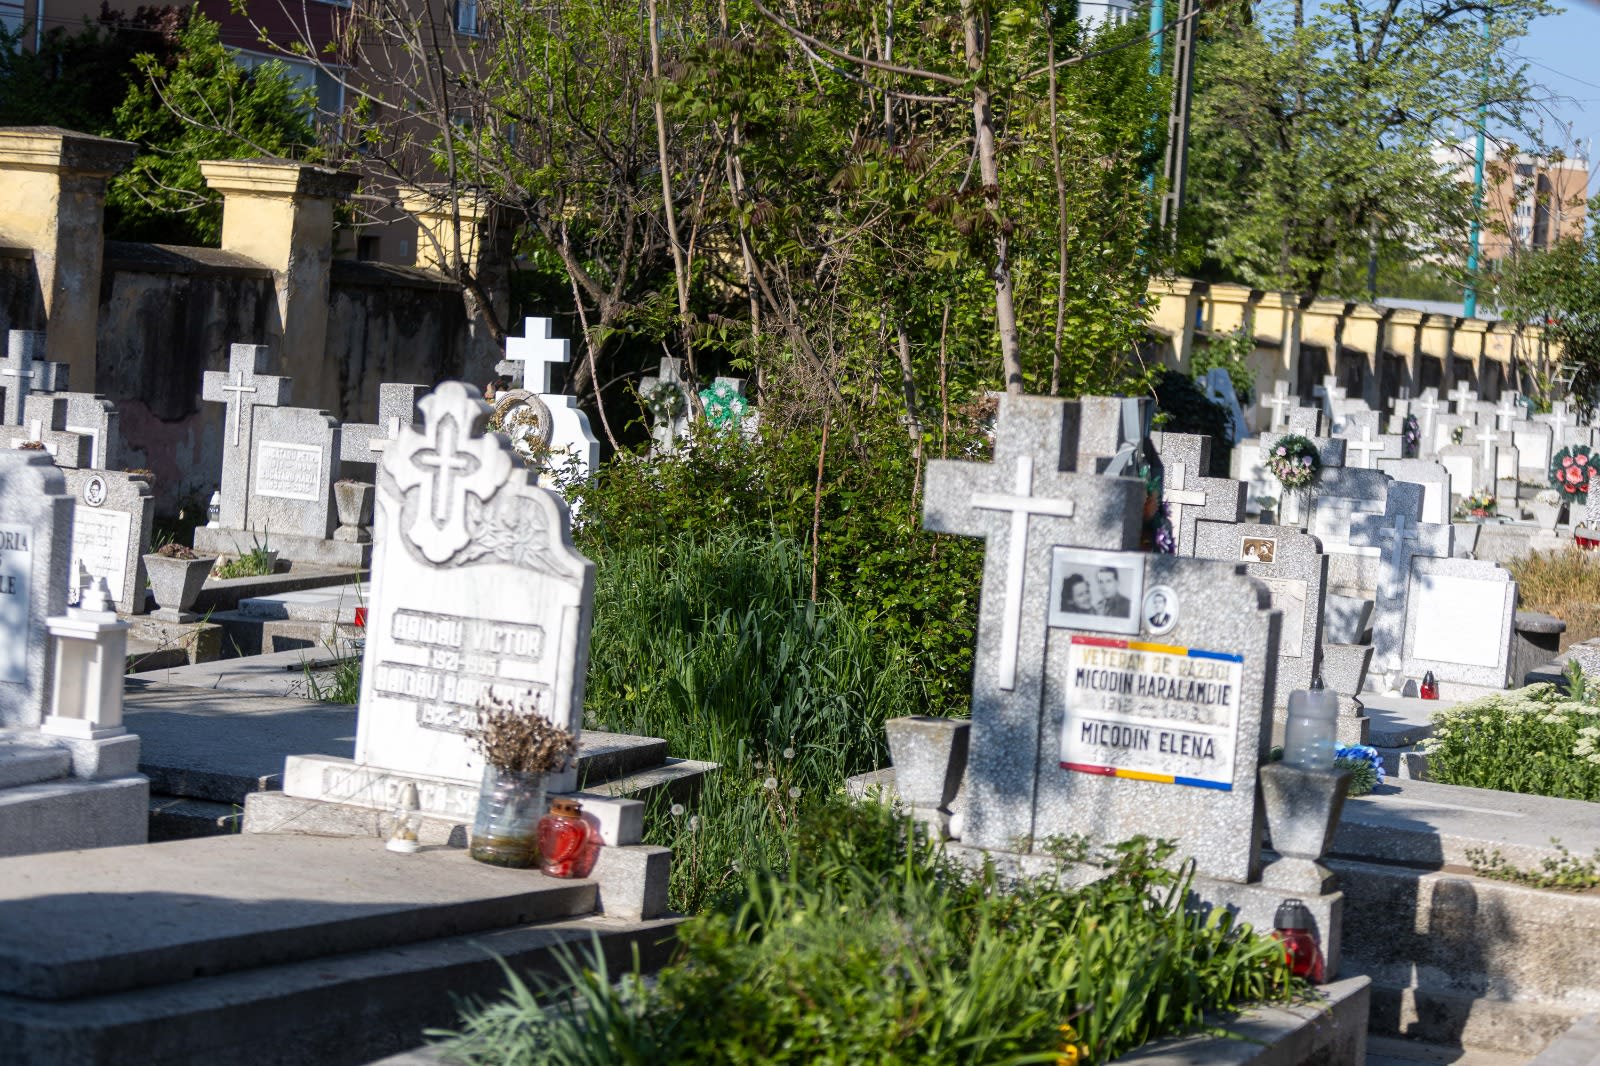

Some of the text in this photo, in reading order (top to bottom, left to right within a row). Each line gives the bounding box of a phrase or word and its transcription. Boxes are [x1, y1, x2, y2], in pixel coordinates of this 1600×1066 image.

[473, 621, 541, 656] VICTOR
[1075, 668, 1133, 694] MICODIN
[1081, 722, 1216, 759] MICODIN ELENA
